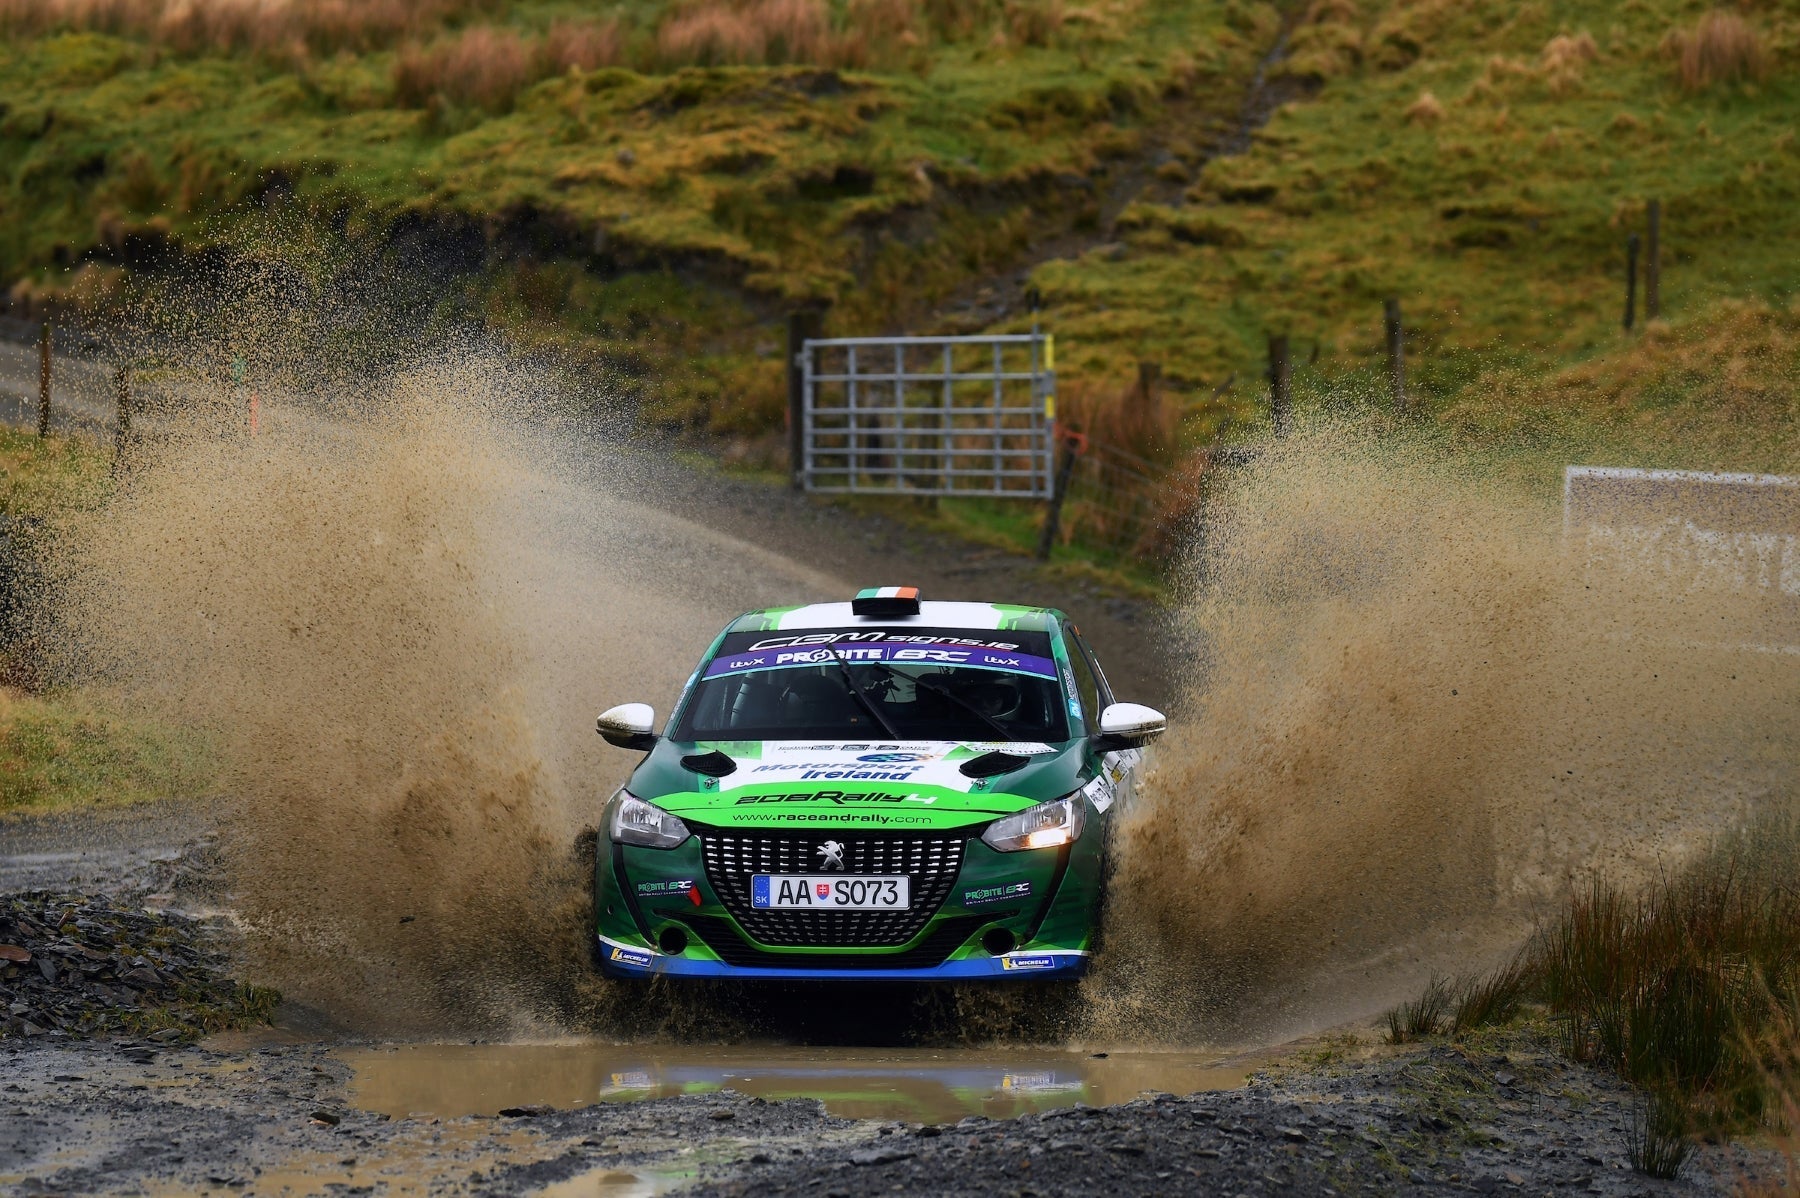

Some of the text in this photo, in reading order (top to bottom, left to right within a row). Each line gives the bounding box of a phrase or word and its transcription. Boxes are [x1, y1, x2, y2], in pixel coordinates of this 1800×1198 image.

[893, 649, 972, 663] BRC
[752, 763, 926, 773] Motorsport
[800, 770, 914, 781] Ireland
[733, 813, 932, 824] www.raceandrally.com
[638, 881, 693, 892] PROBITE BRC
[965, 888, 1003, 900] PROBITE
[1006, 883, 1030, 893] BRC
[778, 880, 813, 905] AA
[755, 896, 768, 904] SK
